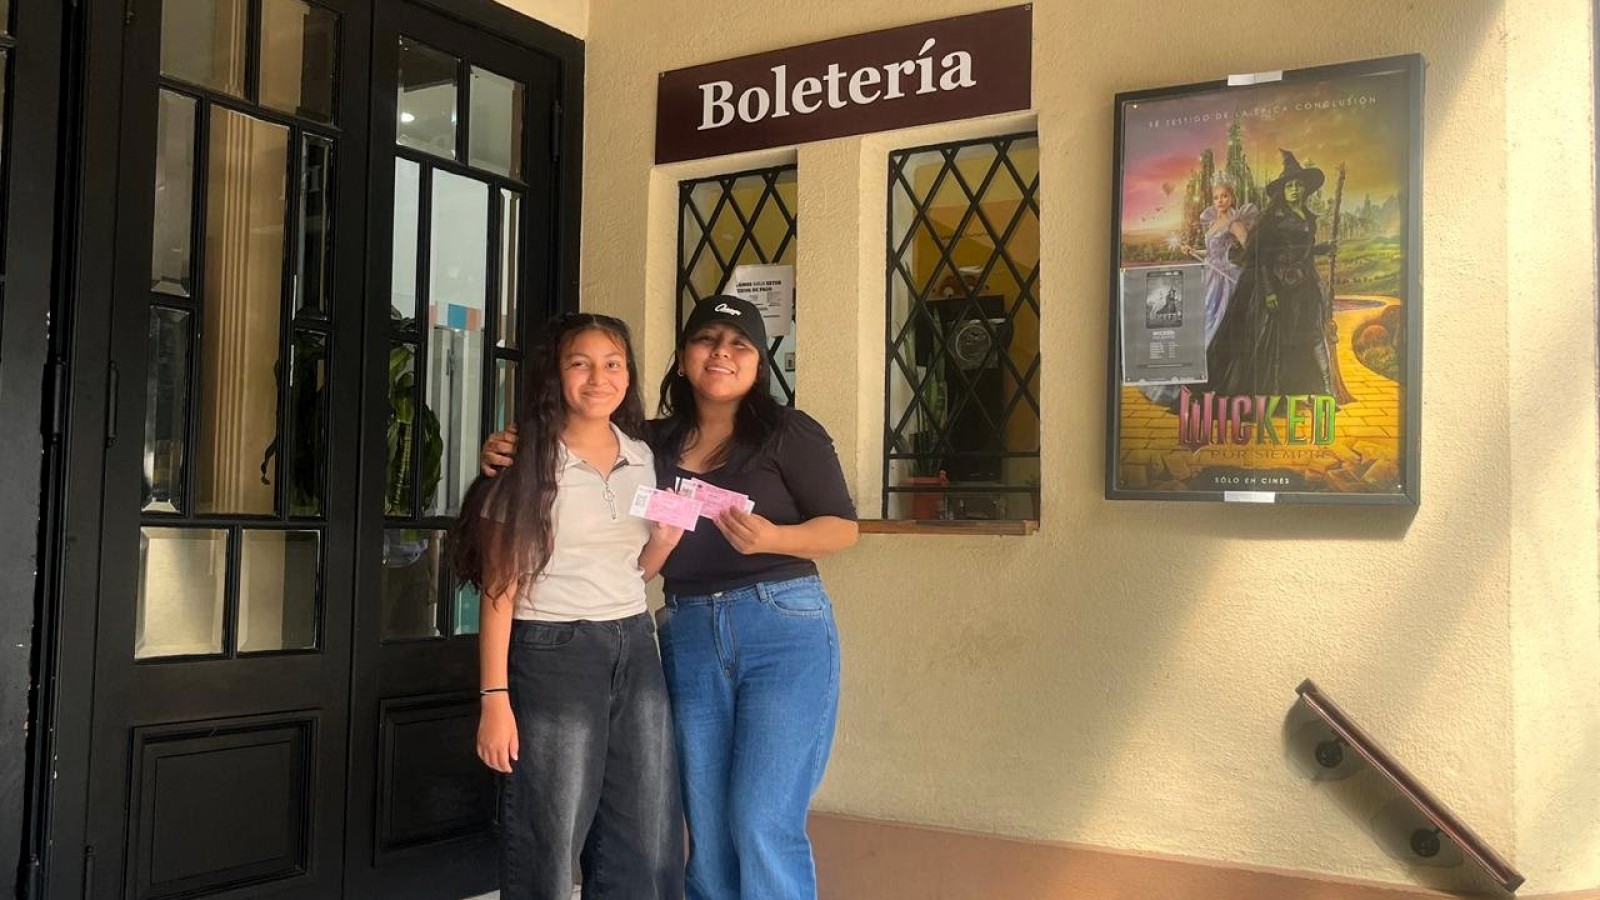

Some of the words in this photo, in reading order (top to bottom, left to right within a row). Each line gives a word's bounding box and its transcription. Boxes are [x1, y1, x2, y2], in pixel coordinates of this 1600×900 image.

[697, 38, 977, 131] Boletería
[1215, 112, 1228, 121] DE
[1179, 385, 1337, 453] WICKED
[1211, 449, 1247, 459] POR
[1261, 477, 1290, 485] CINES
